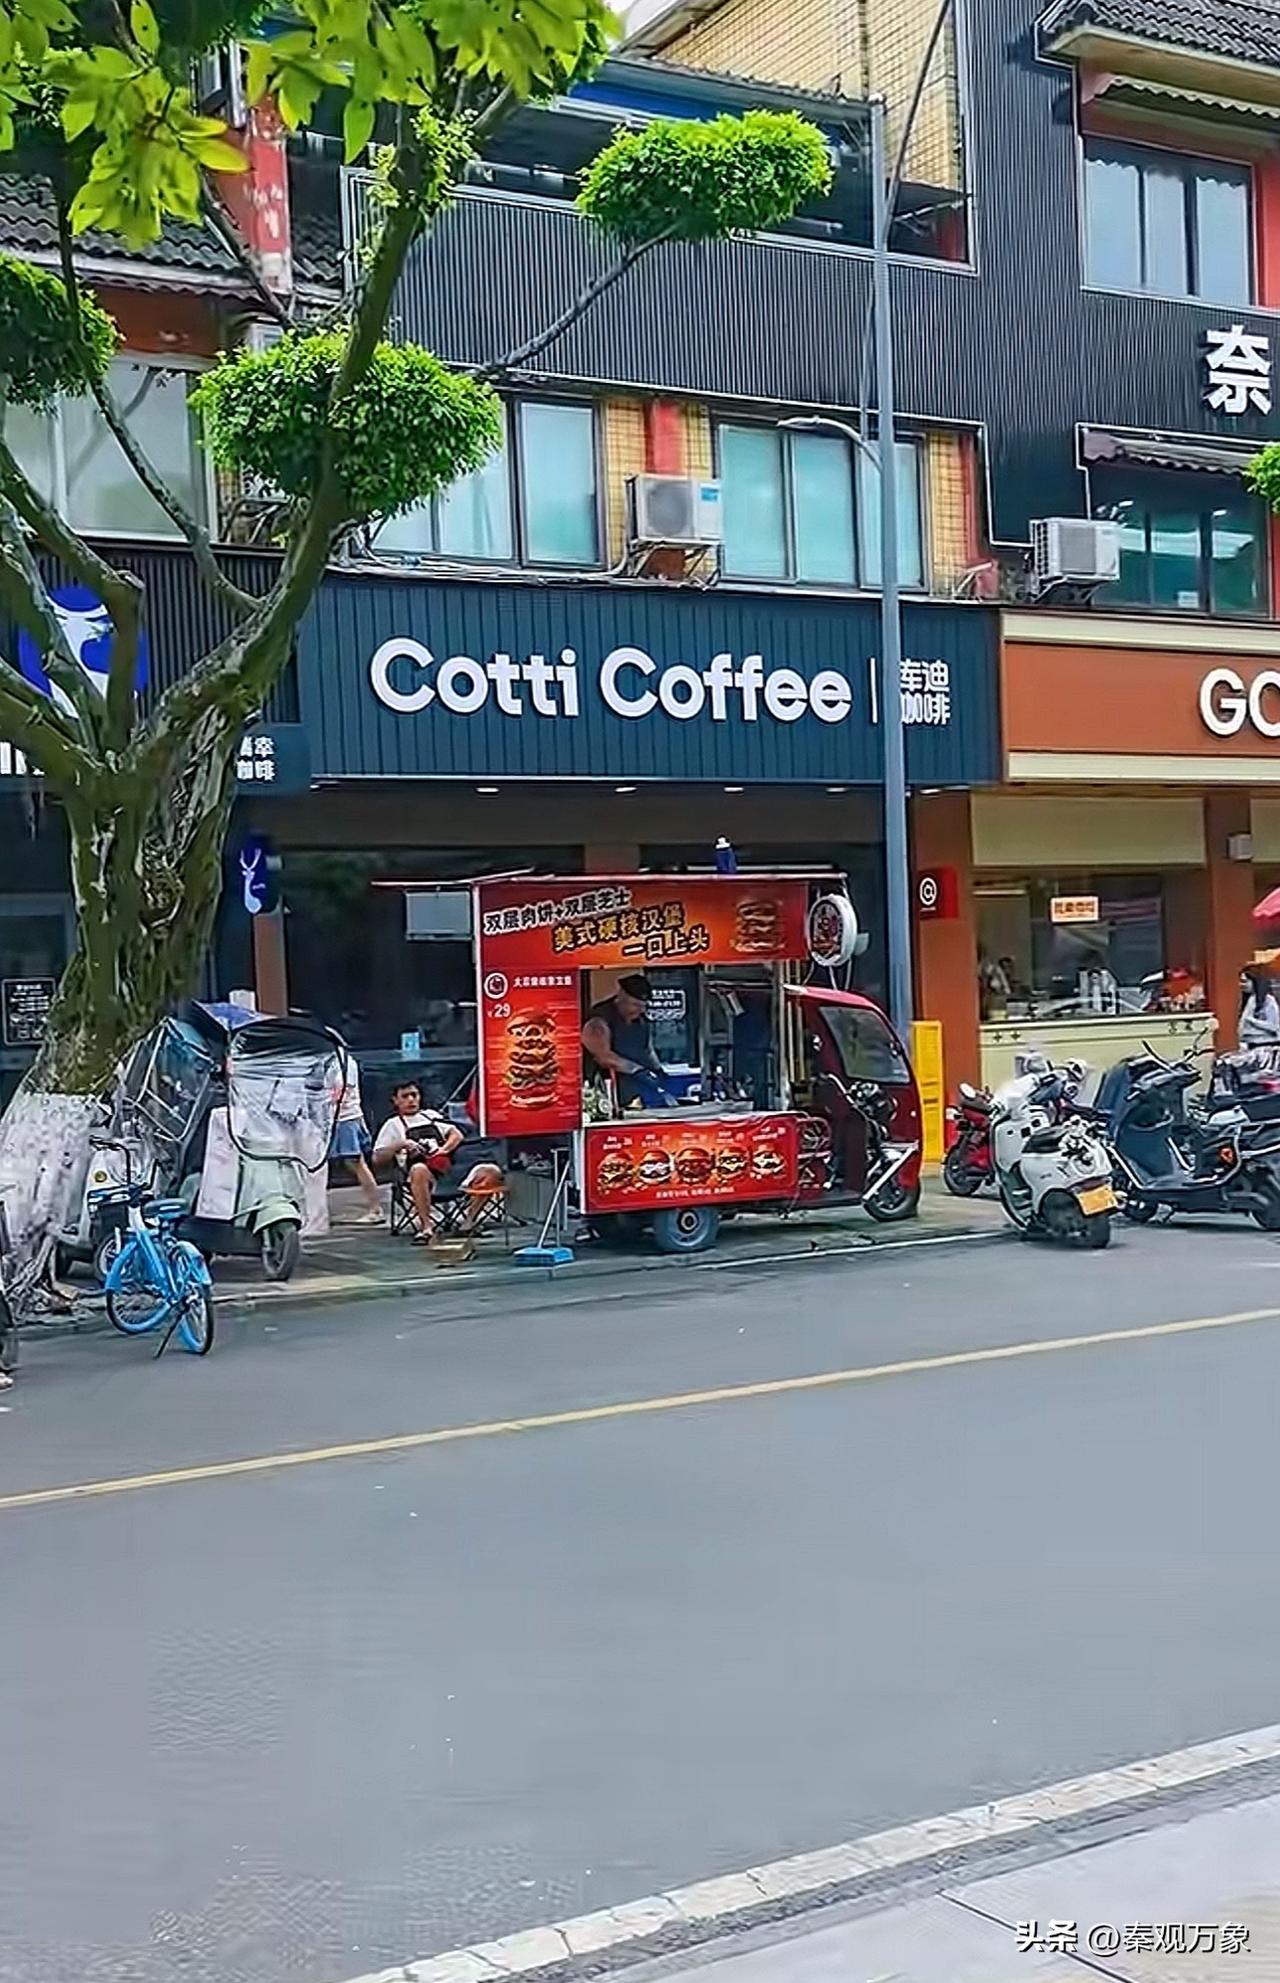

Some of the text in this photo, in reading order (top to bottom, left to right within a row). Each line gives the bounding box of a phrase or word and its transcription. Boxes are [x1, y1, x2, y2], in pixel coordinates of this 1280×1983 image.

[1204, 325, 1272, 415] 奈
[370, 637, 853, 723] Cotti Coffee
[900, 658, 950, 692] 库迪
[485, 886, 632, 934] 双层肉饼+双层芝士
[554, 903, 684, 951] 美式硬核汉堡
[623, 926, 709, 959] 一口上头
